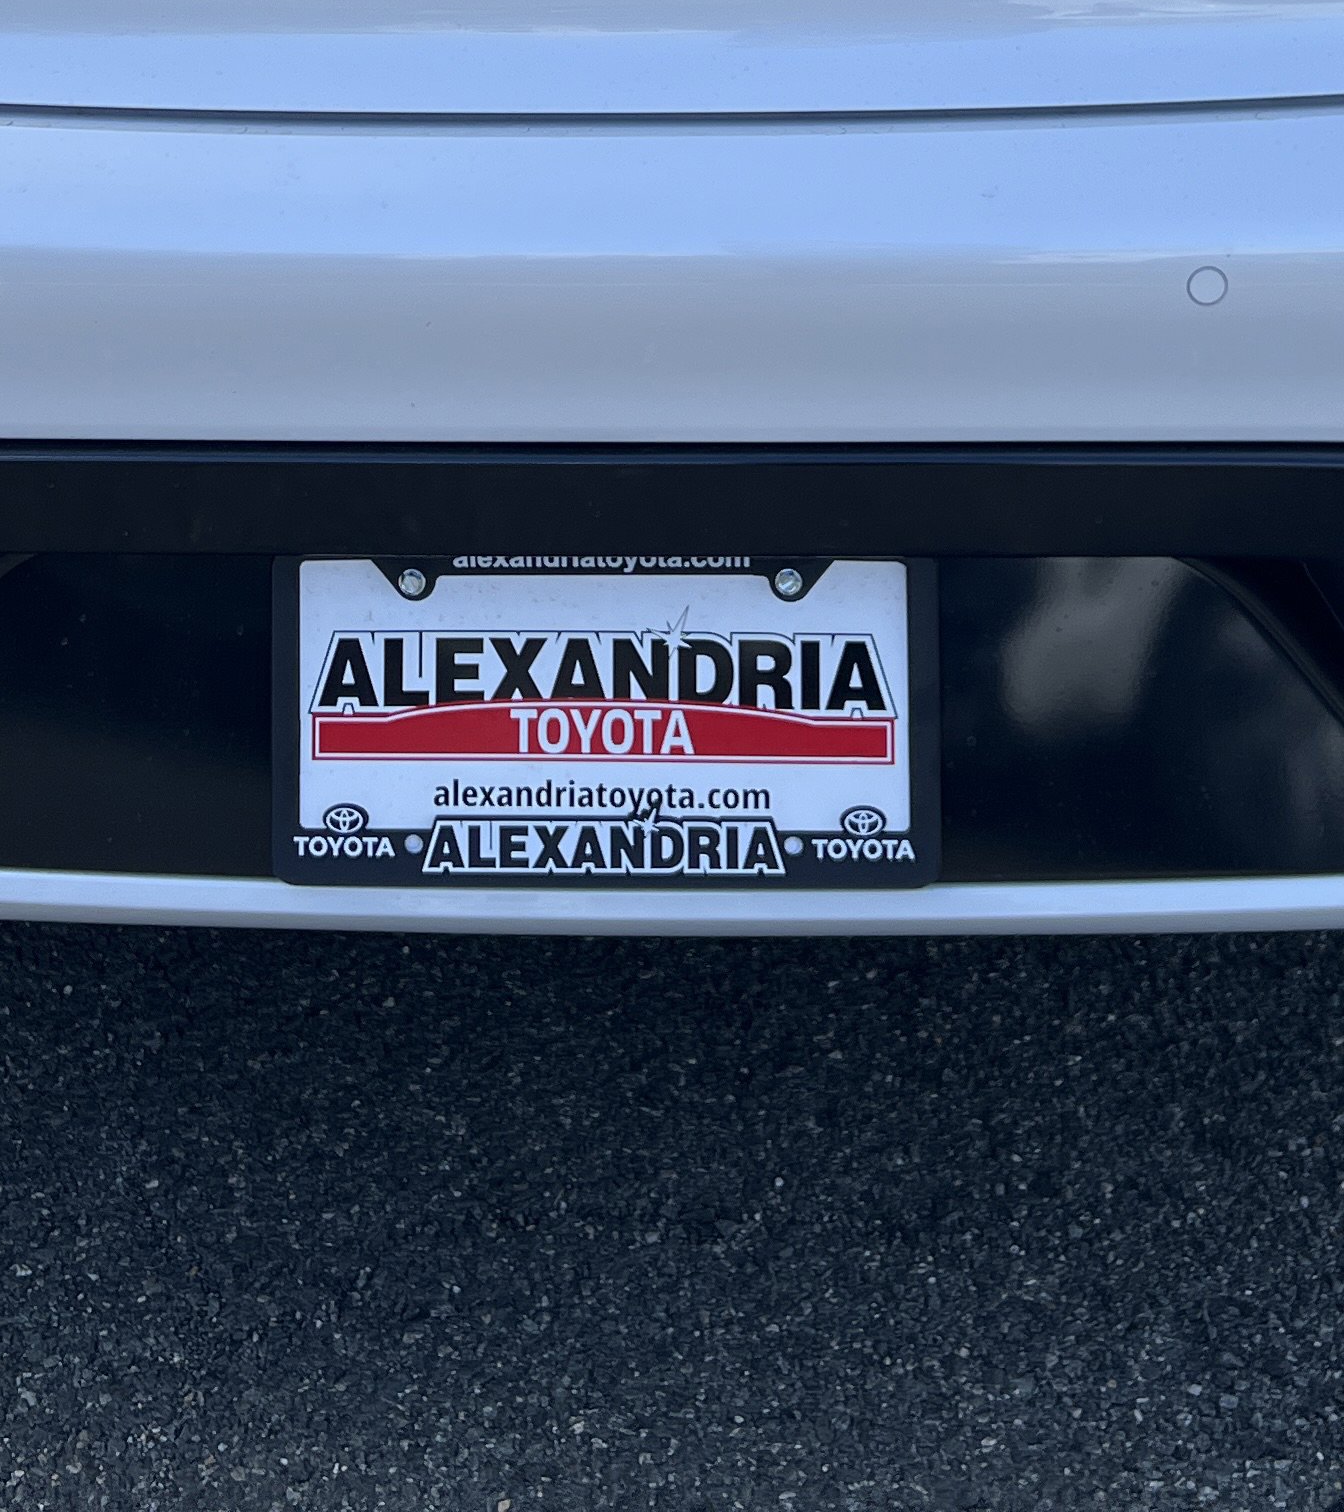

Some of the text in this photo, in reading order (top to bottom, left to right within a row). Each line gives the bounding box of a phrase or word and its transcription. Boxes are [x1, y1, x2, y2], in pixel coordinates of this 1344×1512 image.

[314, 635, 890, 712] ALEXANDRIA
[510, 708, 696, 755] TOYOTA
[433, 778, 771, 815] alexandriatoyota.com
[293, 836, 396, 858] TOYOTA
[425, 820, 784, 873] ALEXANDRIA
[811, 839, 917, 862] TOYOTA
